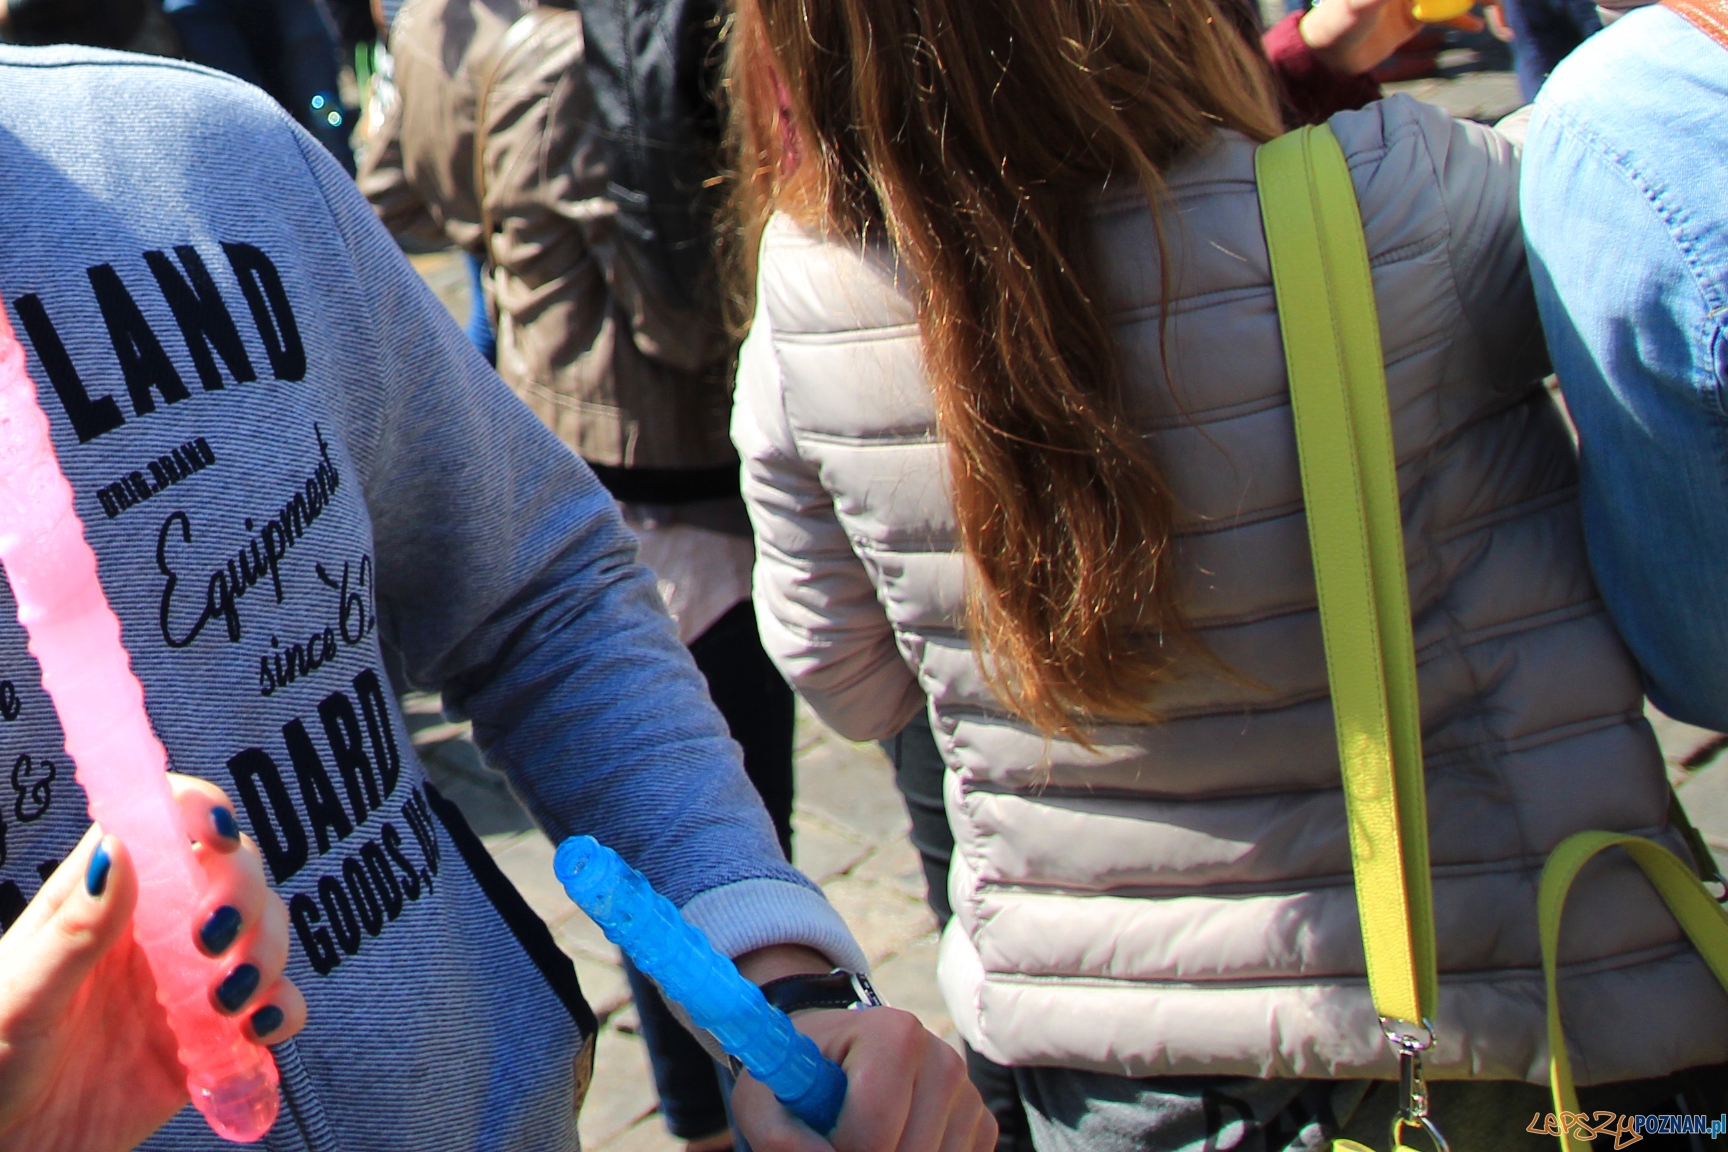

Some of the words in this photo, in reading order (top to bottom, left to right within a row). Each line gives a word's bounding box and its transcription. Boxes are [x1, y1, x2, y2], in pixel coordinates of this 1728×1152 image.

[12, 240, 307, 445] LAND
[156, 421, 339, 648] Equipment
[259, 626, 337, 697] since
